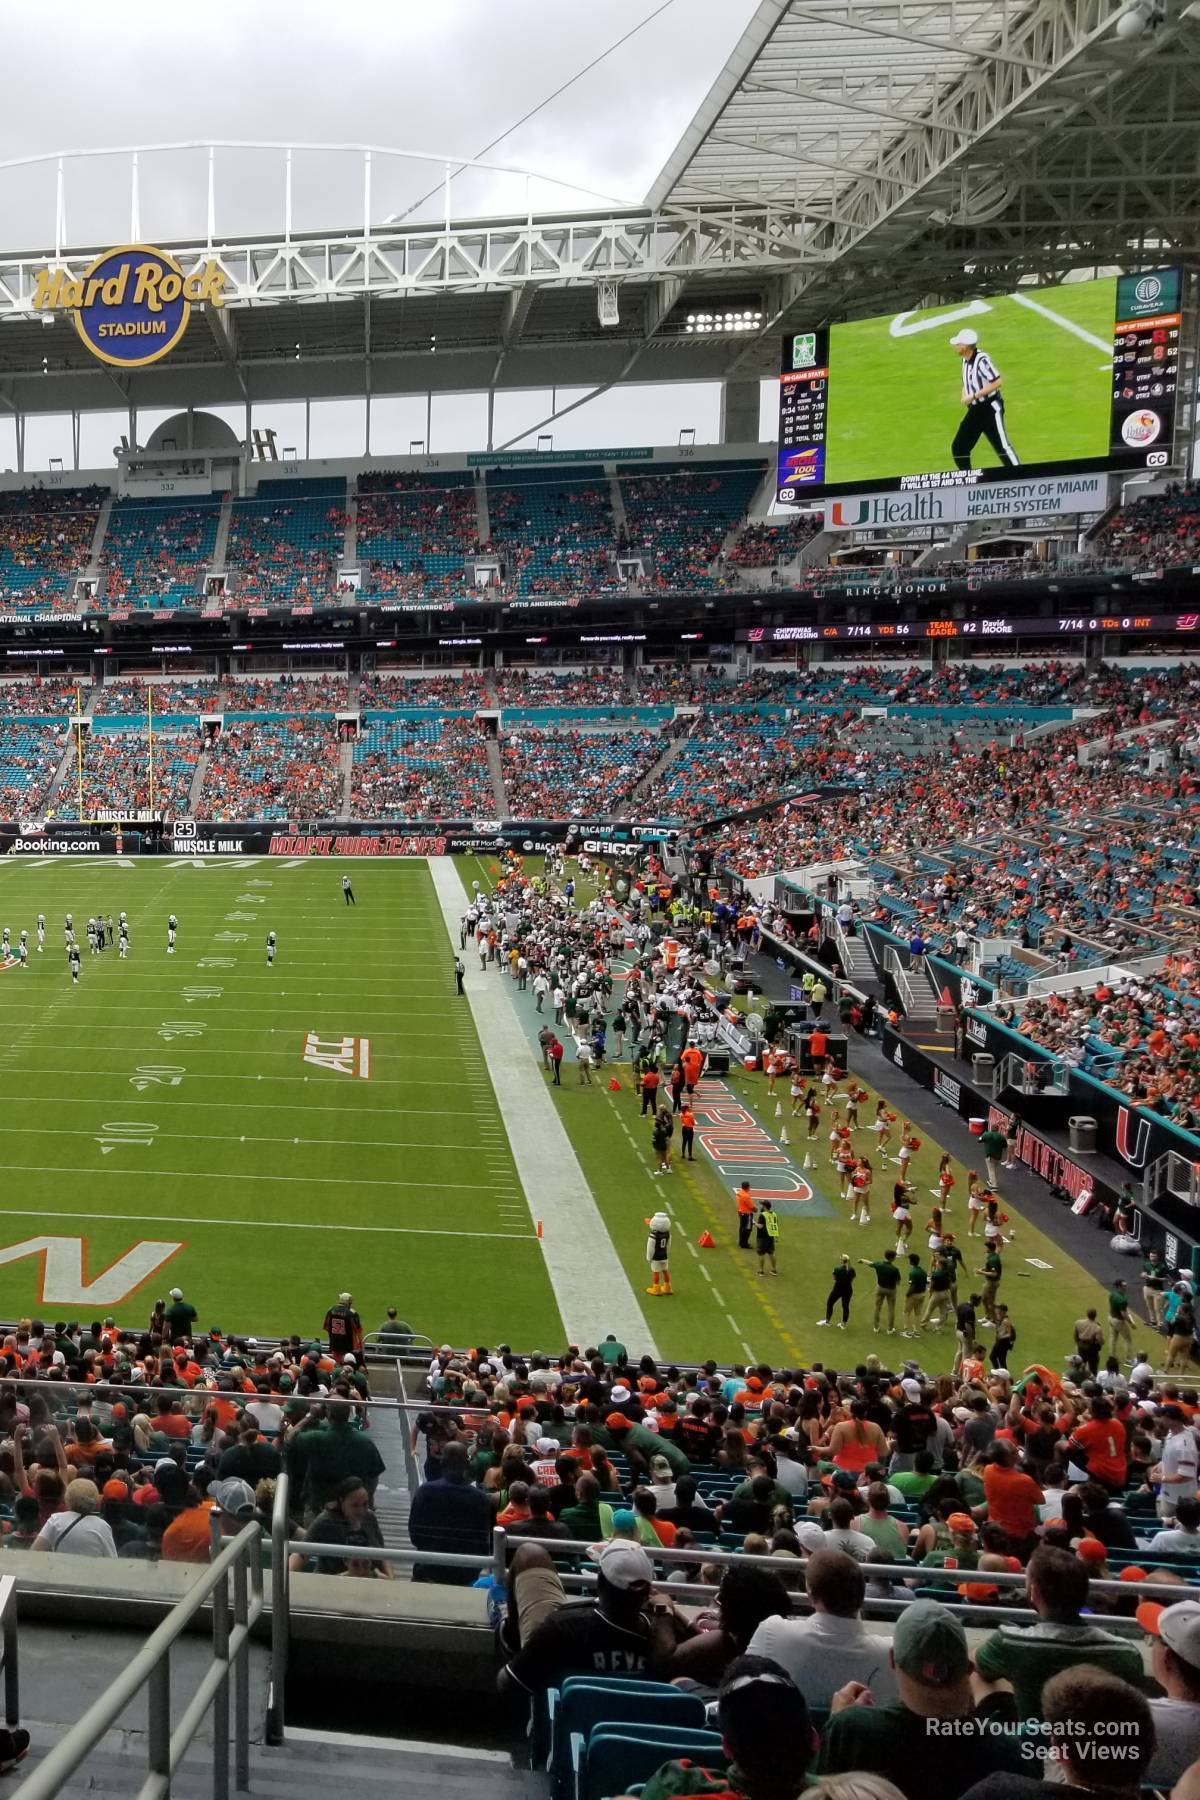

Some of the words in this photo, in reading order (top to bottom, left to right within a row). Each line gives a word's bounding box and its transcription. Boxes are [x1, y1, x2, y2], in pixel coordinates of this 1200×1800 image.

[34, 263, 130, 309] Hard
[133, 258, 225, 312] Rock
[98, 320, 166, 337] STADIUM
[951, 470, 967, 478] YARD
[965, 476, 977, 484] THE
[160, 483, 175, 491] 332
[968, 485, 1036, 502] UNIVERSITY
[1038, 483, 1055, 496] OF
[1056, 479, 1098, 494] MIAMI
[781, 490, 794, 500] CC
[967, 501, 1011, 517] HEALTH
[1013, 497, 1061, 513] SYSTEM
[847, 587, 881, 596] RING
[895, 584, 947, 595] HONOR
[34, 613, 82, 622] CHAMPIONS
[963, 624, 976, 632] #2
[1059, 620, 1084, 629] 7/14
[1089, 620, 1097, 629] 0
[1122, 619, 1130, 628] 0
[1134, 619, 1151, 627] INT
[824, 628, 837, 636] C/A
[848, 626, 871, 636] 7/14
[897, 626, 909, 634] 56
[97, 811, 136, 821] MUSCLE
[137, 811, 162, 821] MILK
[177, 825, 193, 836] 25
[15, 838, 99, 852] Booking.com
[174, 840, 215, 853] MUSCLE
[217, 840, 243, 852] MILK
[269, 837, 332, 855] MIAMI
[584, 840, 644, 856] GEICO
[1115, 1105, 1151, 1168] U
[1107, 1436, 1117, 1457] 1
